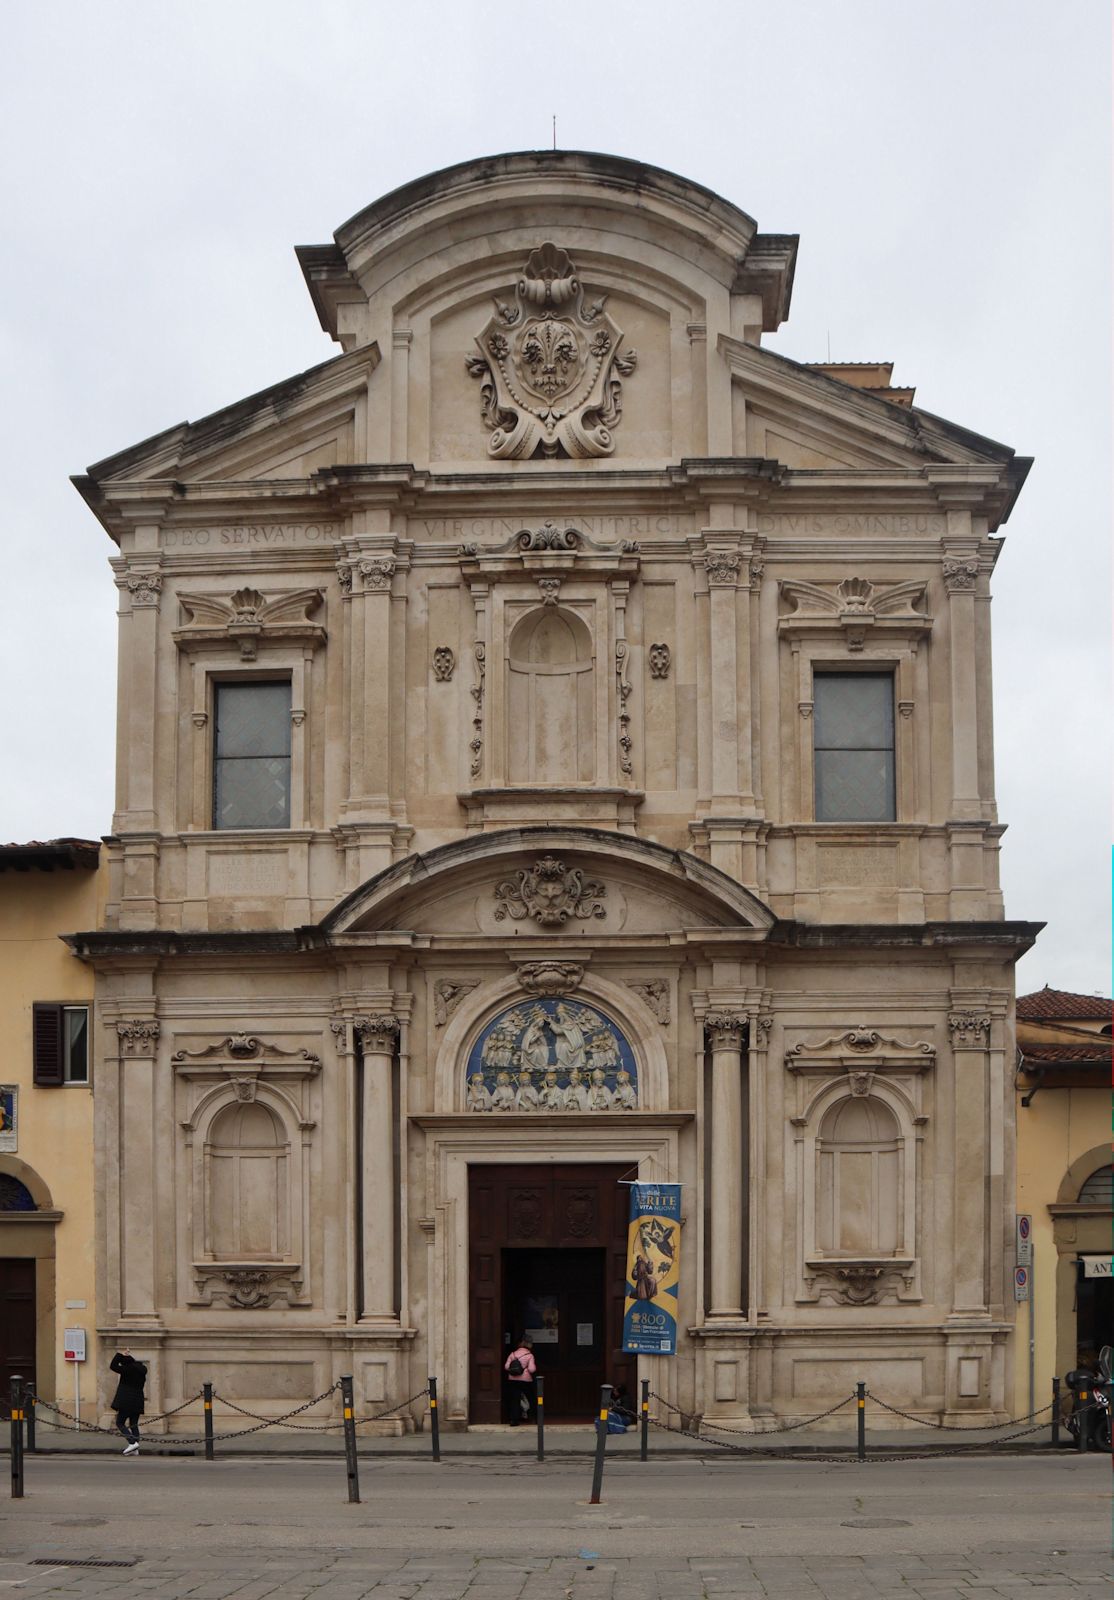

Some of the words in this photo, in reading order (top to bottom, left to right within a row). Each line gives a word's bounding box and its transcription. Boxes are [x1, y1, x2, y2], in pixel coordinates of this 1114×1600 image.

[424, 519, 523, 537] VIRGINI
[760, 515, 824, 533] DIVIS
[834, 515, 942, 533] OMNIBUS
[165, 528, 210, 546] DEO
[221, 523, 341, 545] SERVATORI
[641, 1312, 666, 1325] 800
